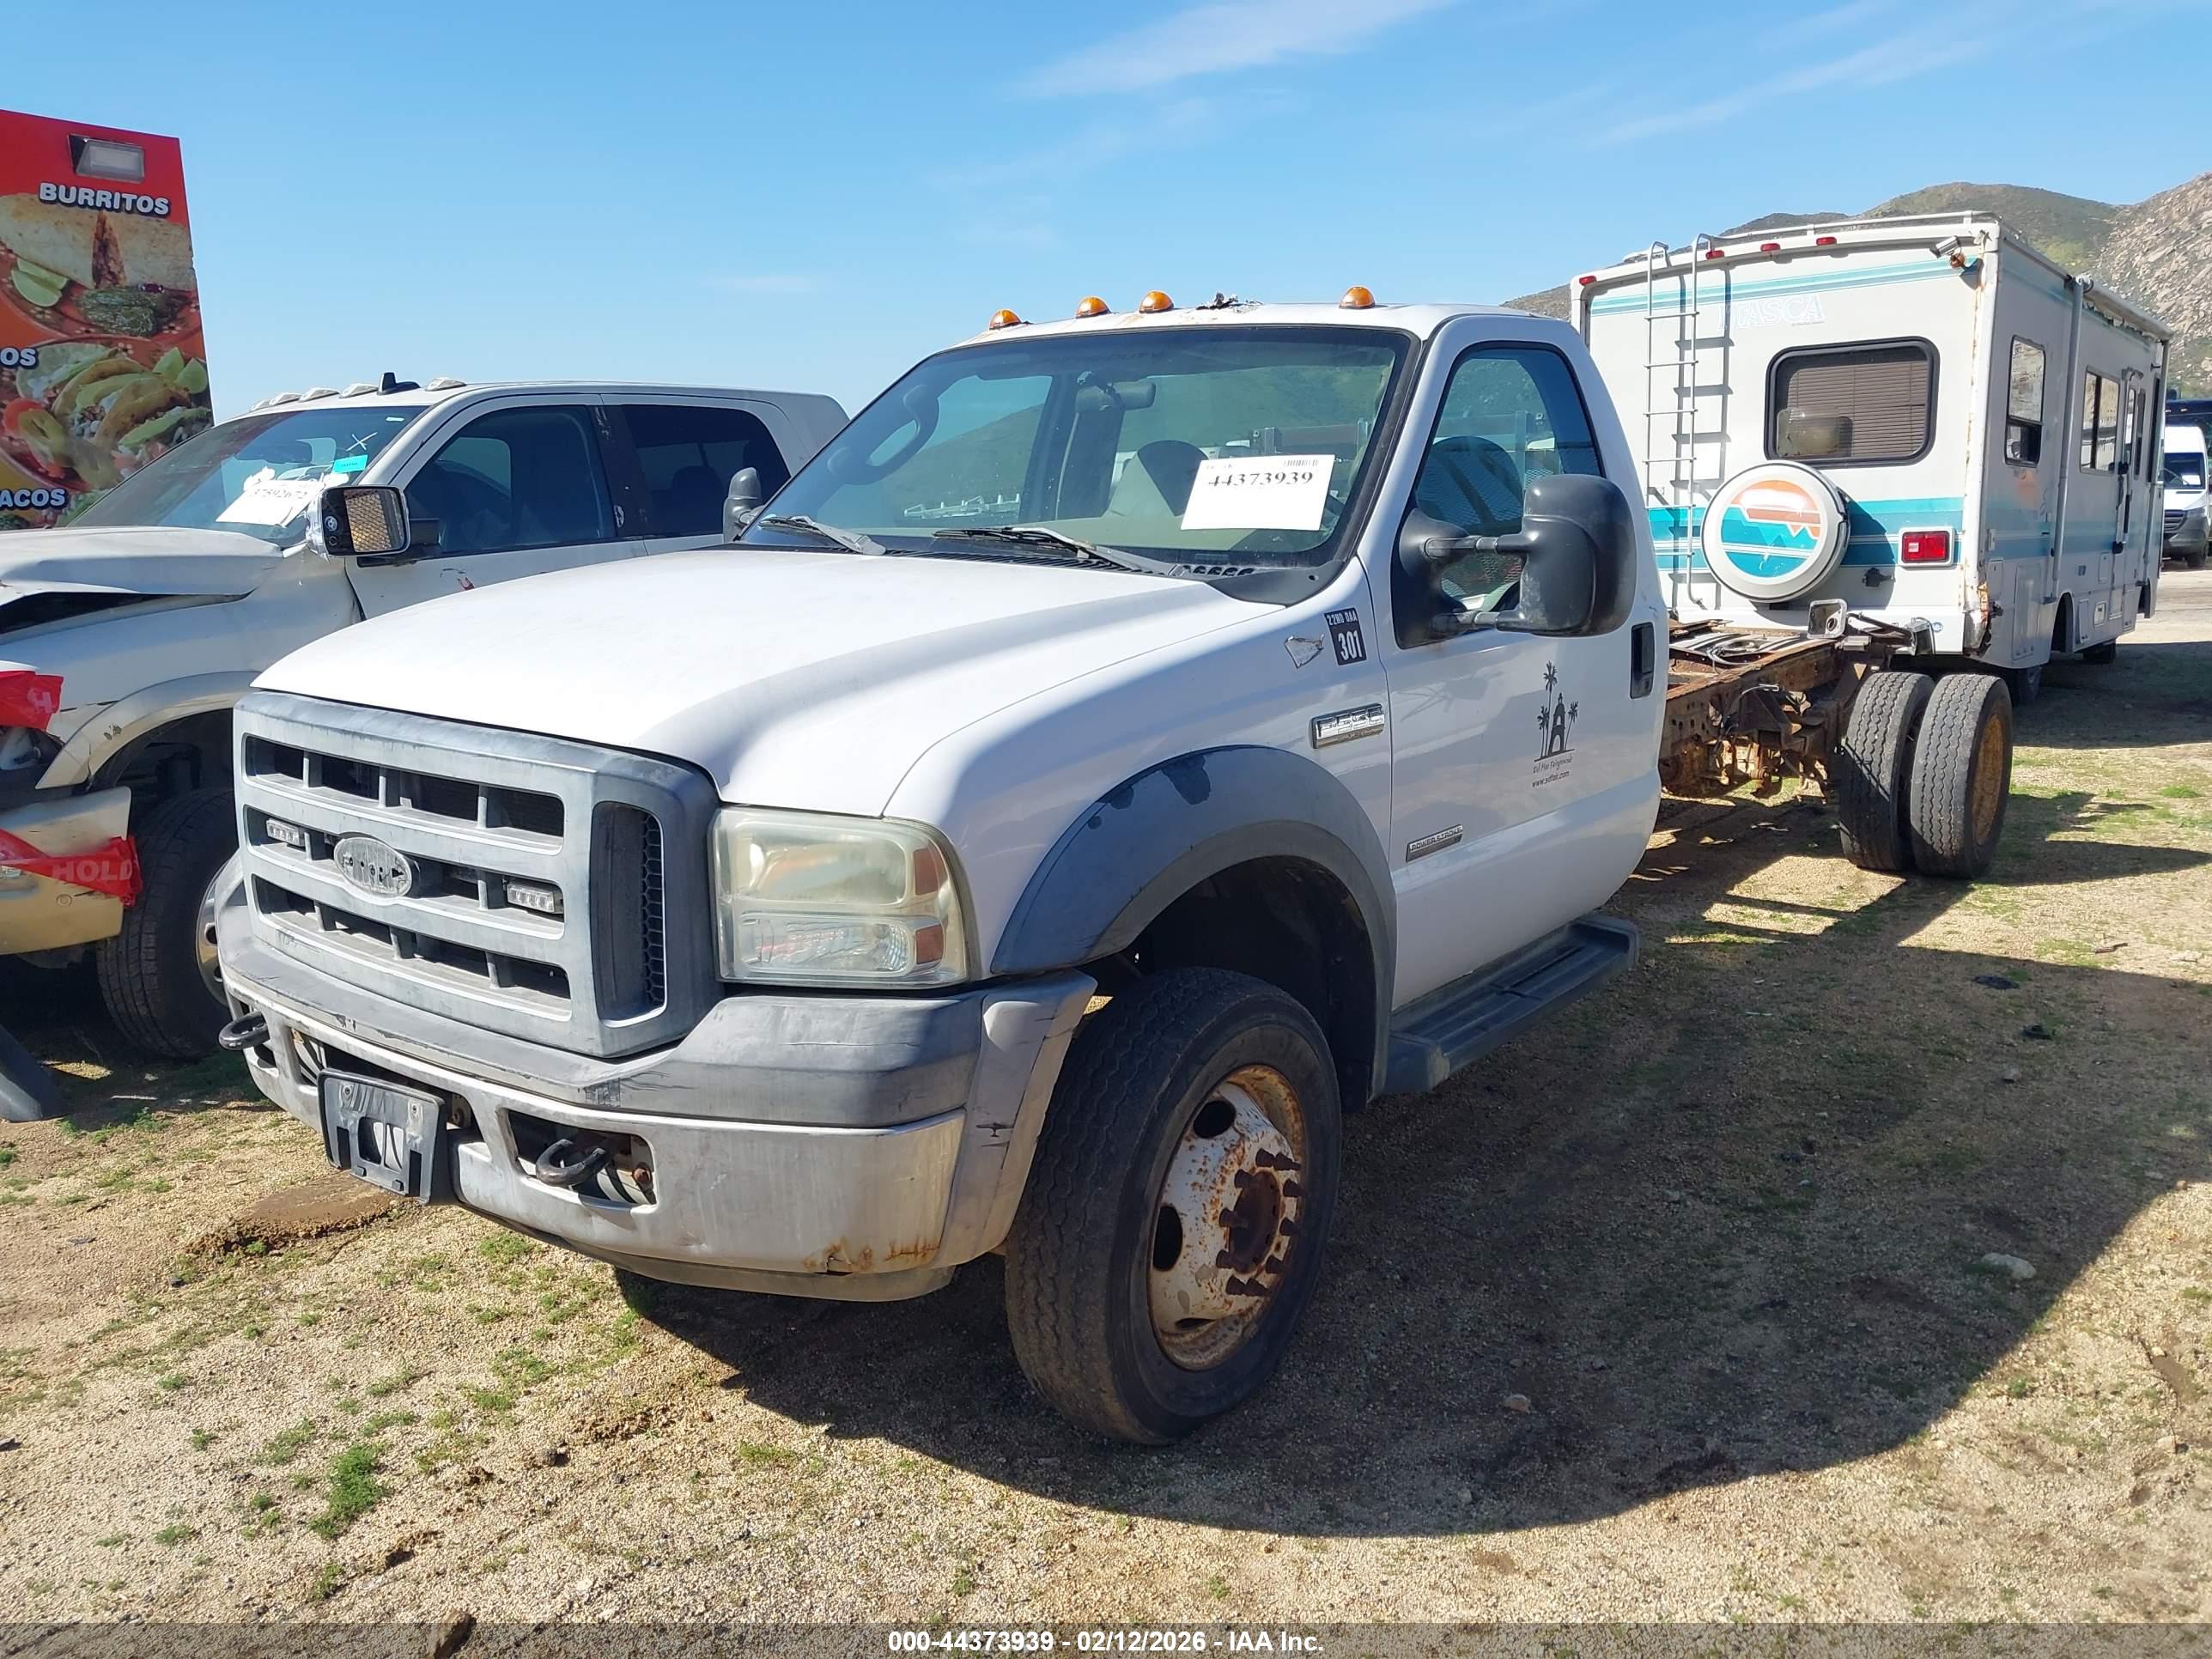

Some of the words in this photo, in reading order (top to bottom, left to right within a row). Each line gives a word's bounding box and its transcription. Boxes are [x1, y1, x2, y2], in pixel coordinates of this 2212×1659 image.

[39, 182, 170, 216] BURRITOS
[1208, 471, 1314, 488] 44373939
[1326, 612, 1345, 626] 22ND
[1338, 629, 1364, 661] 301
[52, 859, 133, 883] HOLD
